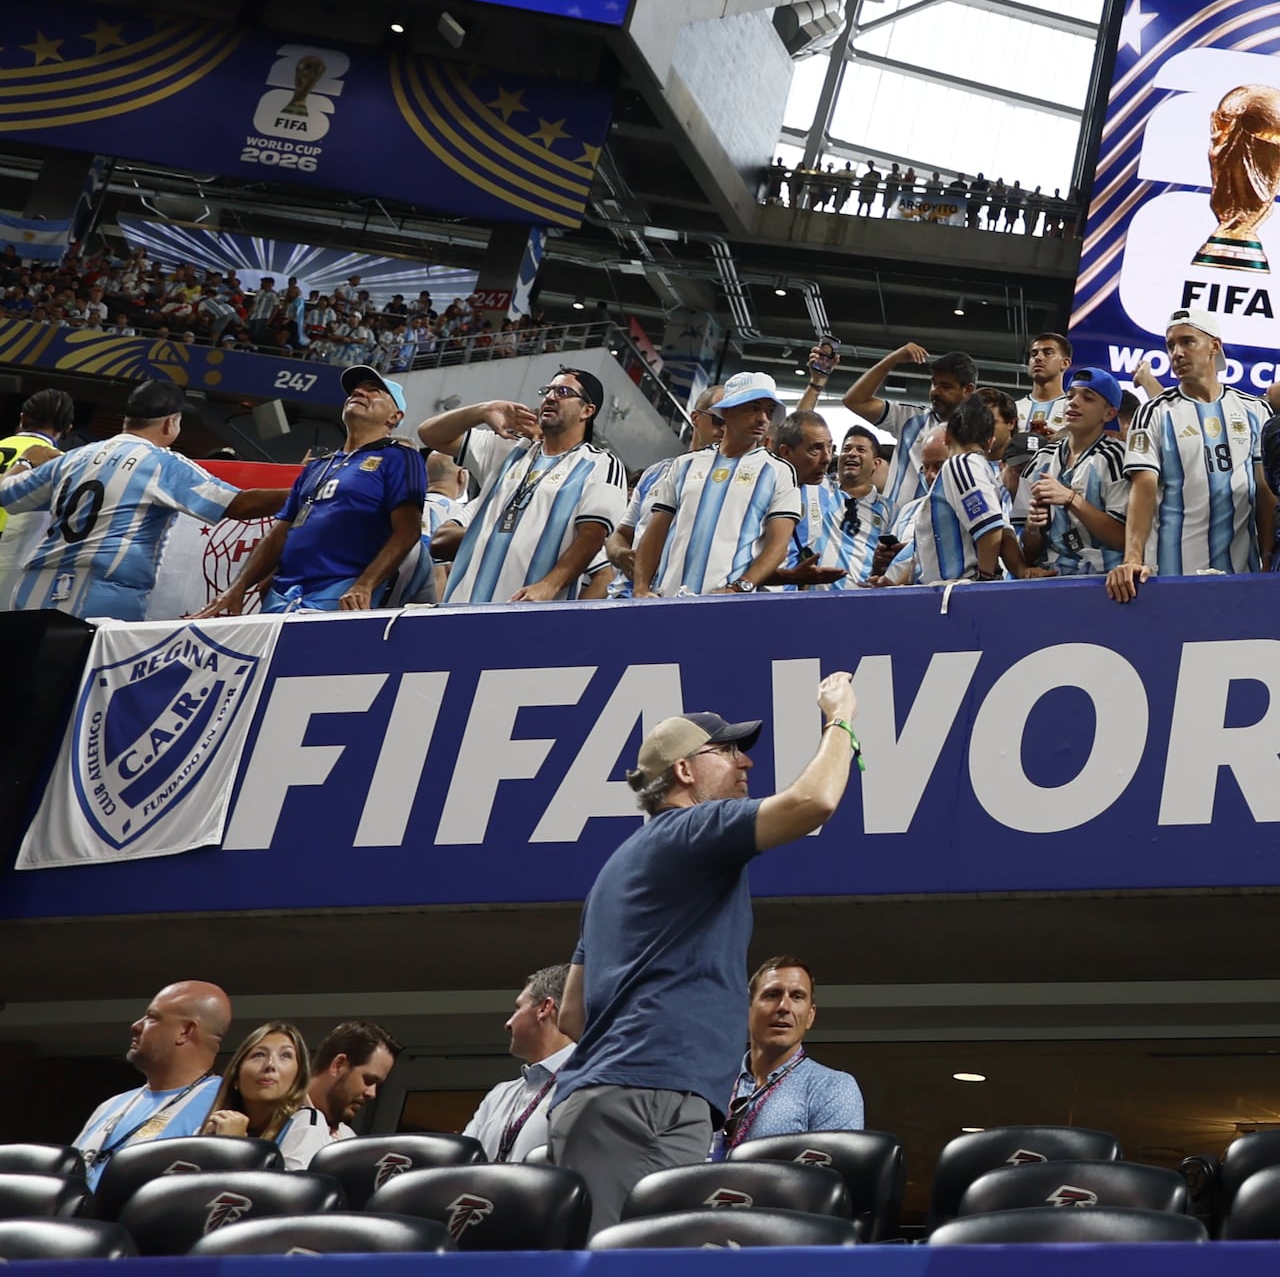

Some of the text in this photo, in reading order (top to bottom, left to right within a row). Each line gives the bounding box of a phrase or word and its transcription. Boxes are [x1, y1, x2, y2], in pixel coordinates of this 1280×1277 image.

[274, 117, 308, 132] FIFA
[240, 147, 318, 172] 2026
[246, 136, 322, 156] WORLD CUP
[1181, 280, 1274, 319] FIFA
[274, 370, 318, 392] 247
[1108, 344, 1244, 385] WOD
[129, 639, 219, 682] REGINA
[118, 687, 209, 781] C.A.R.
[87, 711, 117, 816] CLUB ATLETICO
[221, 663, 688, 850] FIFA
[143, 753, 200, 817] FUNDADO
